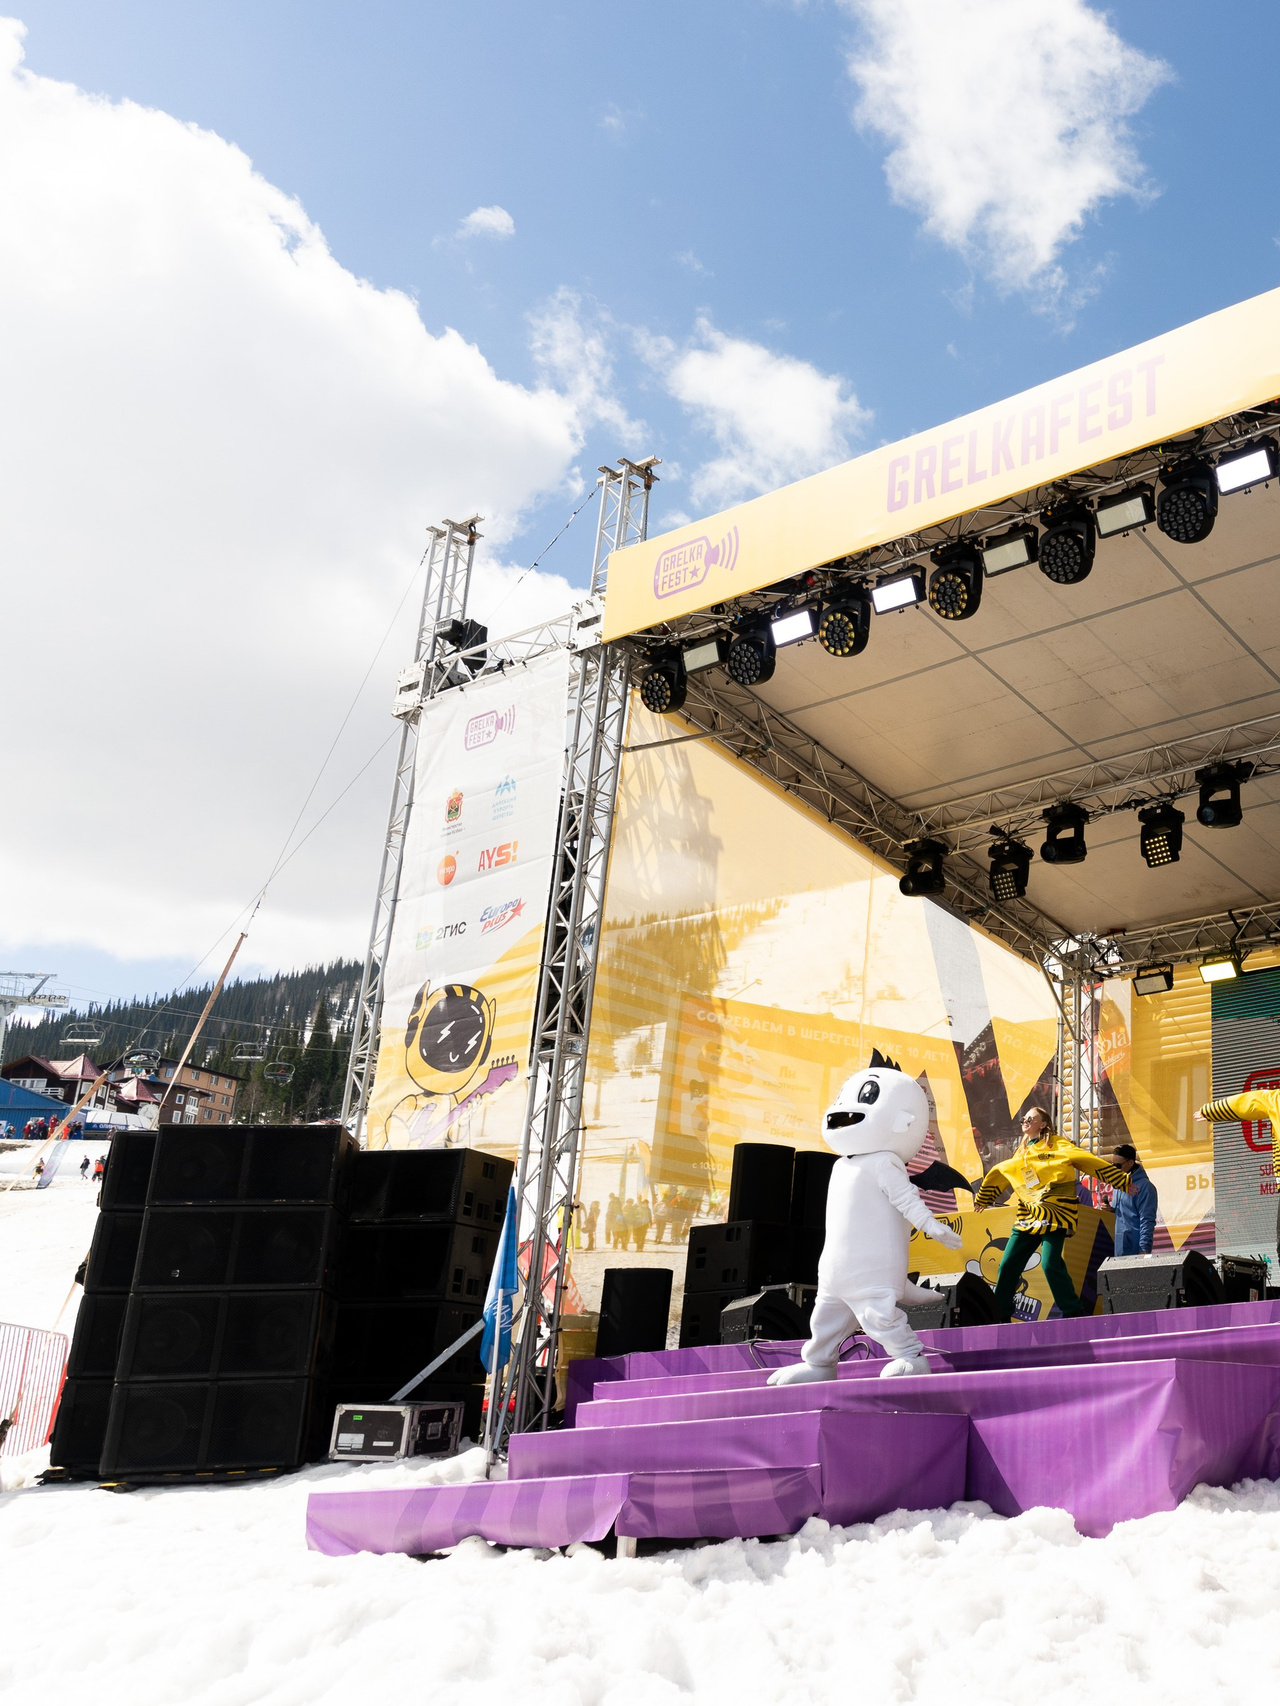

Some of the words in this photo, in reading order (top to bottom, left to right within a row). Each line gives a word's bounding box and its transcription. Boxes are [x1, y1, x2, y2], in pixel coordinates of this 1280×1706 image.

[886, 354, 1166, 513] GRELKAFEST
[662, 543, 703, 573] GRELKA
[661, 567, 689, 592] FEST
[469, 716, 494, 734] GRELKA
[468, 731, 487, 746] FEST
[478, 841, 518, 872] AYS!
[434, 922, 467, 942] 2ГИС
